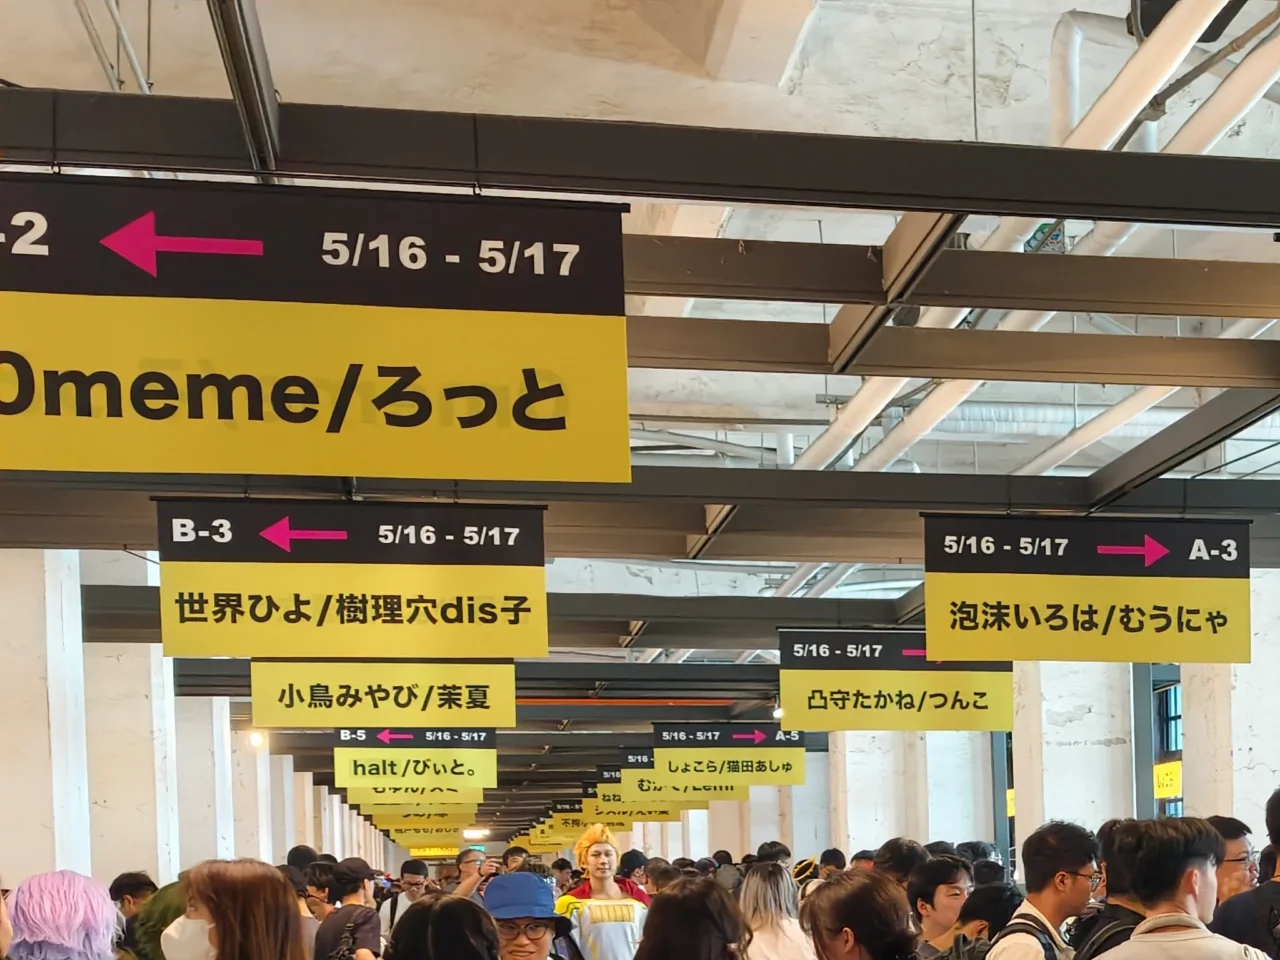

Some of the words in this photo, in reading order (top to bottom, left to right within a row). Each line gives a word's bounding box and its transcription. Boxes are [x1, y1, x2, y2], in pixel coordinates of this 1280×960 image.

[321, 231, 427, 270] 5/16
[445, 254, 460, 264] -
[478, 240, 581, 276] 5/17
[171, 518, 233, 543] B-3
[378, 525, 436, 545] 5/16
[463, 526, 520, 546] 5/17
[943, 535, 995, 555] 5/16
[1019, 537, 1069, 556] 5/17
[1188, 538, 1238, 562] A-3
[174, 592, 532, 627] 世界ひよ/樹理穴dis子
[949, 600, 1228, 636] 泡沫いろは/むうにゃ
[793, 643, 830, 657] 5/16
[846, 644, 883, 658] 5/17
[277, 682, 491, 712] 小鳥みやび/茉夏
[807, 689, 989, 713] 凸守たかね/つんこ
[340, 730, 367, 741] B-5
[425, 731, 451, 741] 5/16
[461, 732, 487, 741] 5/17
[662, 731, 687, 741] 5/16
[696, 731, 720, 741] 5/17
[775, 731, 800, 741] A-5
[353, 759, 397, 776] halt
[627, 755, 649, 763] 5/16
[668, 760, 793, 775] しょこら/猫田あしゅ
